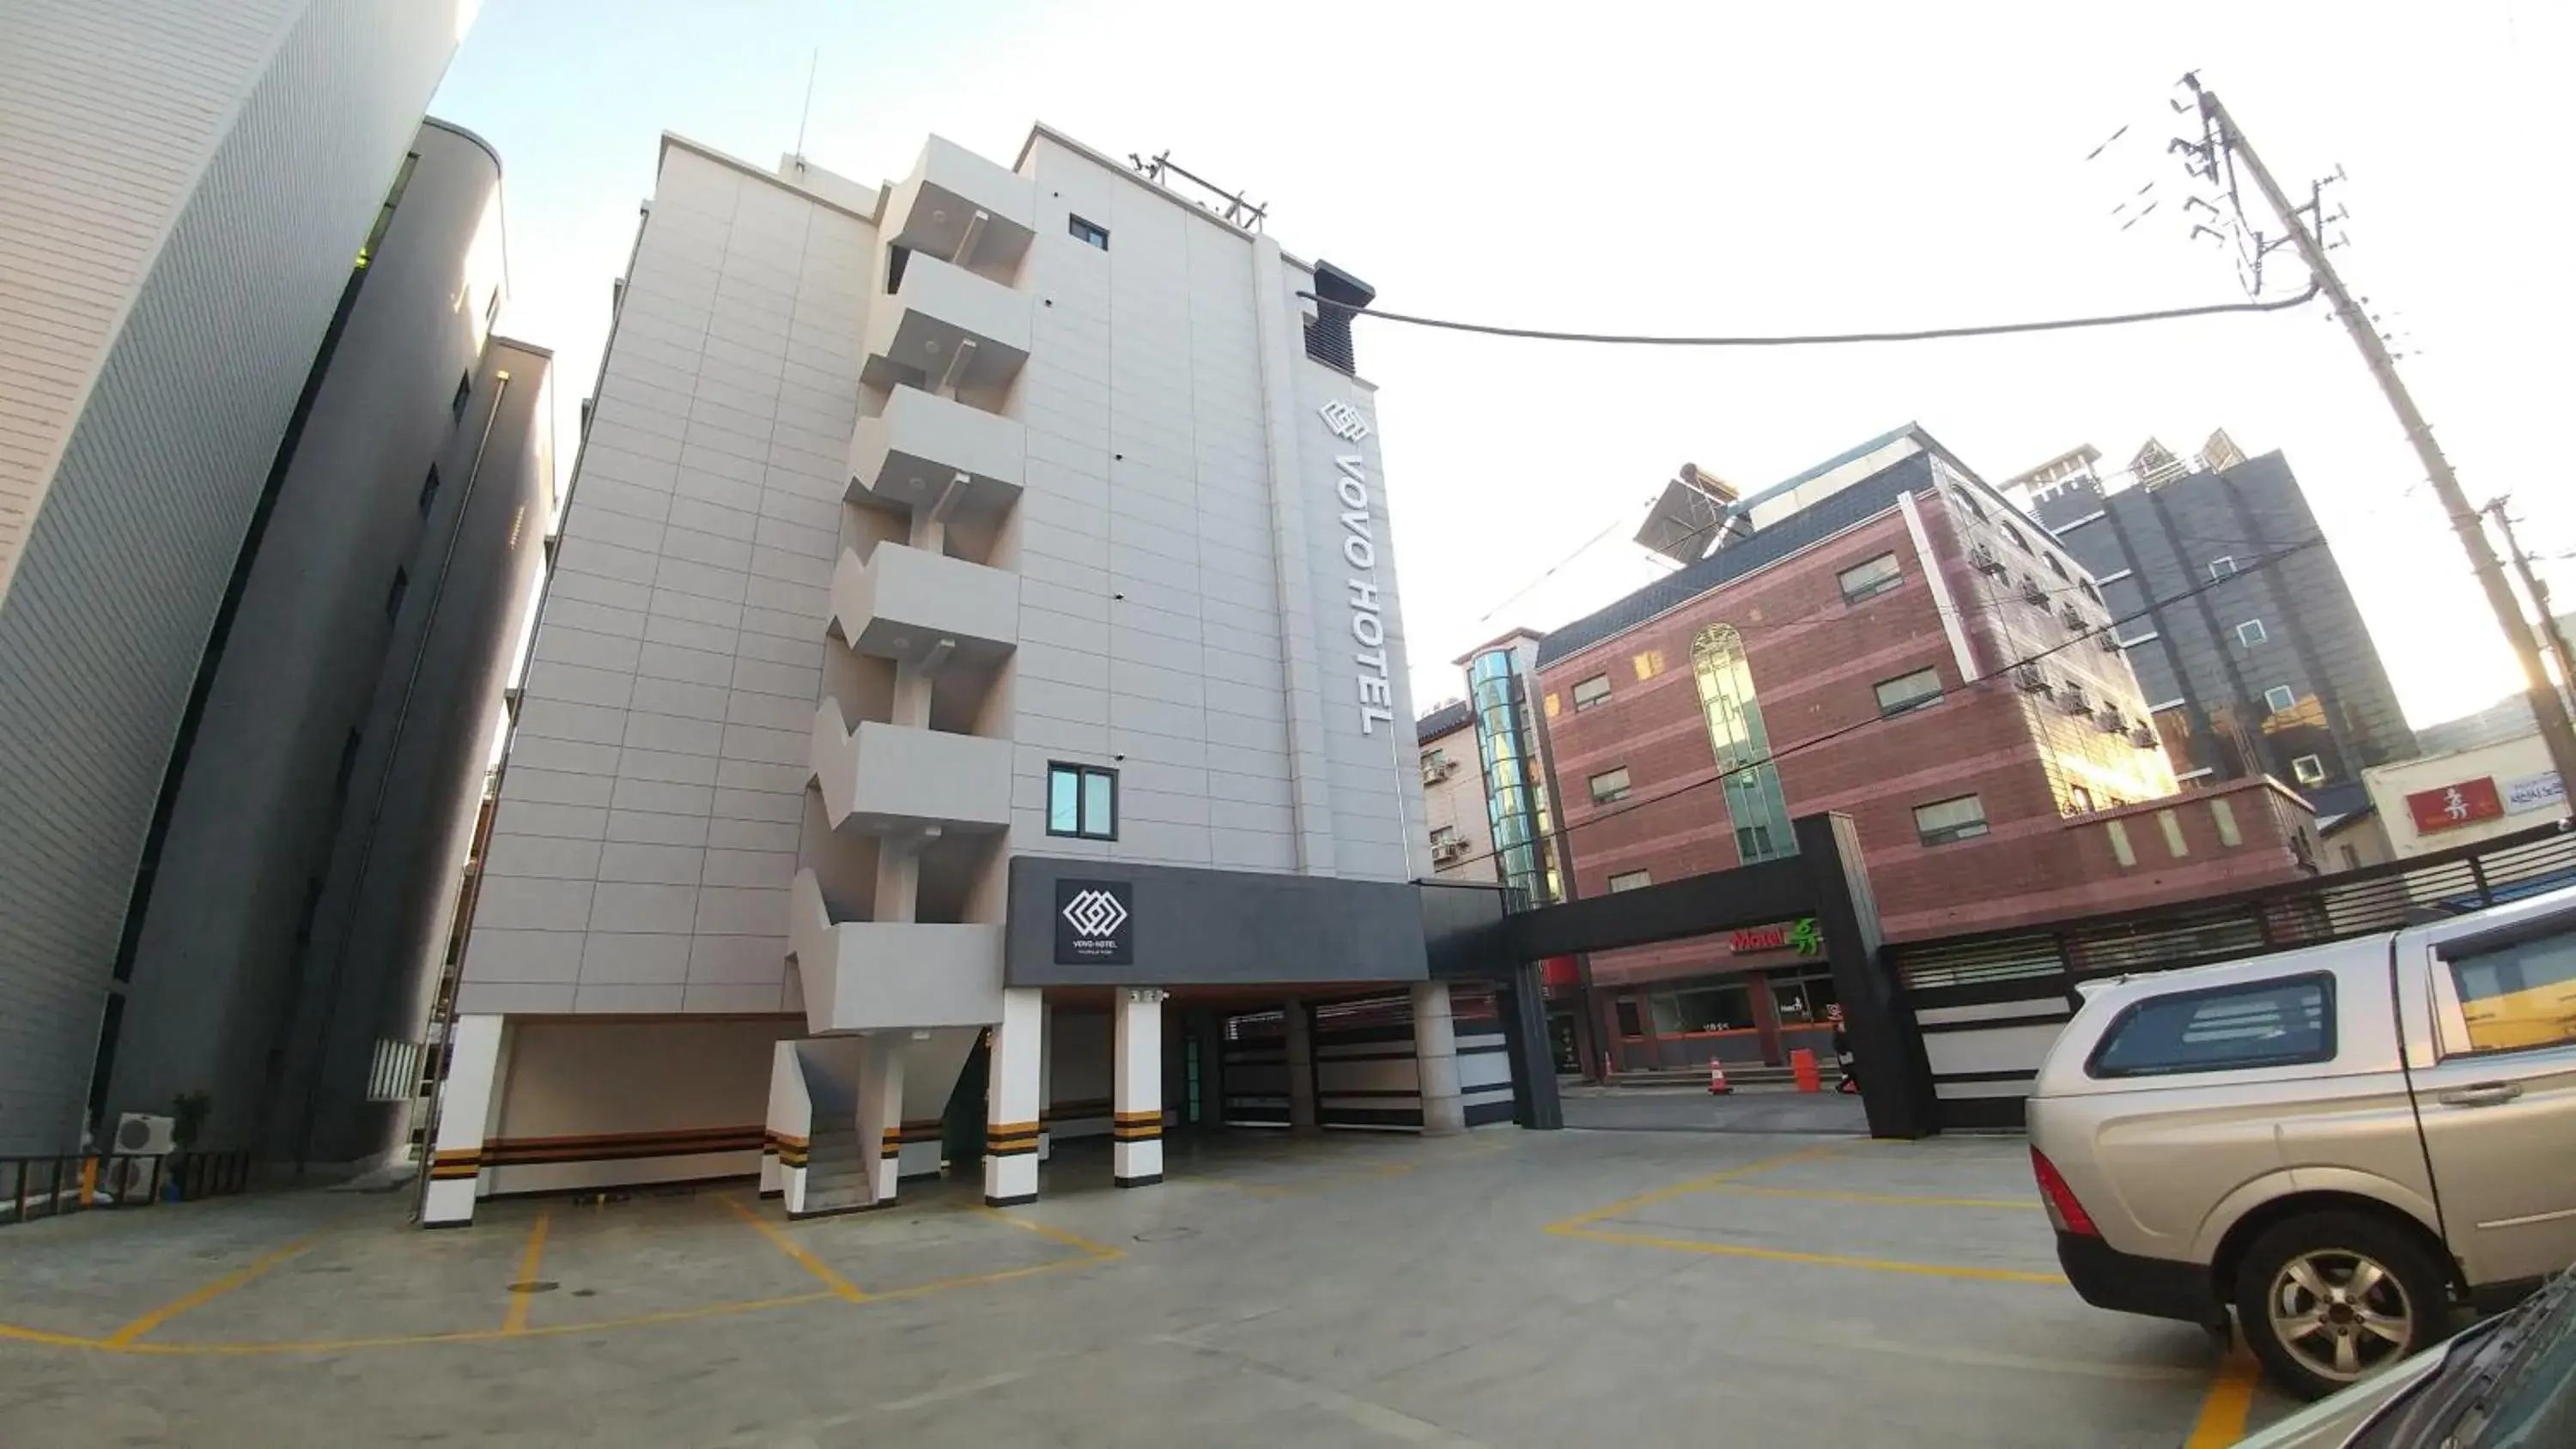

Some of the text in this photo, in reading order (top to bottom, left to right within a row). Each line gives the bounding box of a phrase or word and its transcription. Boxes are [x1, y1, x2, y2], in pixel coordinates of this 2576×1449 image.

[1335, 454, 1394, 735] VOVO HOTEL
[1730, 927, 1784, 952] Motel
